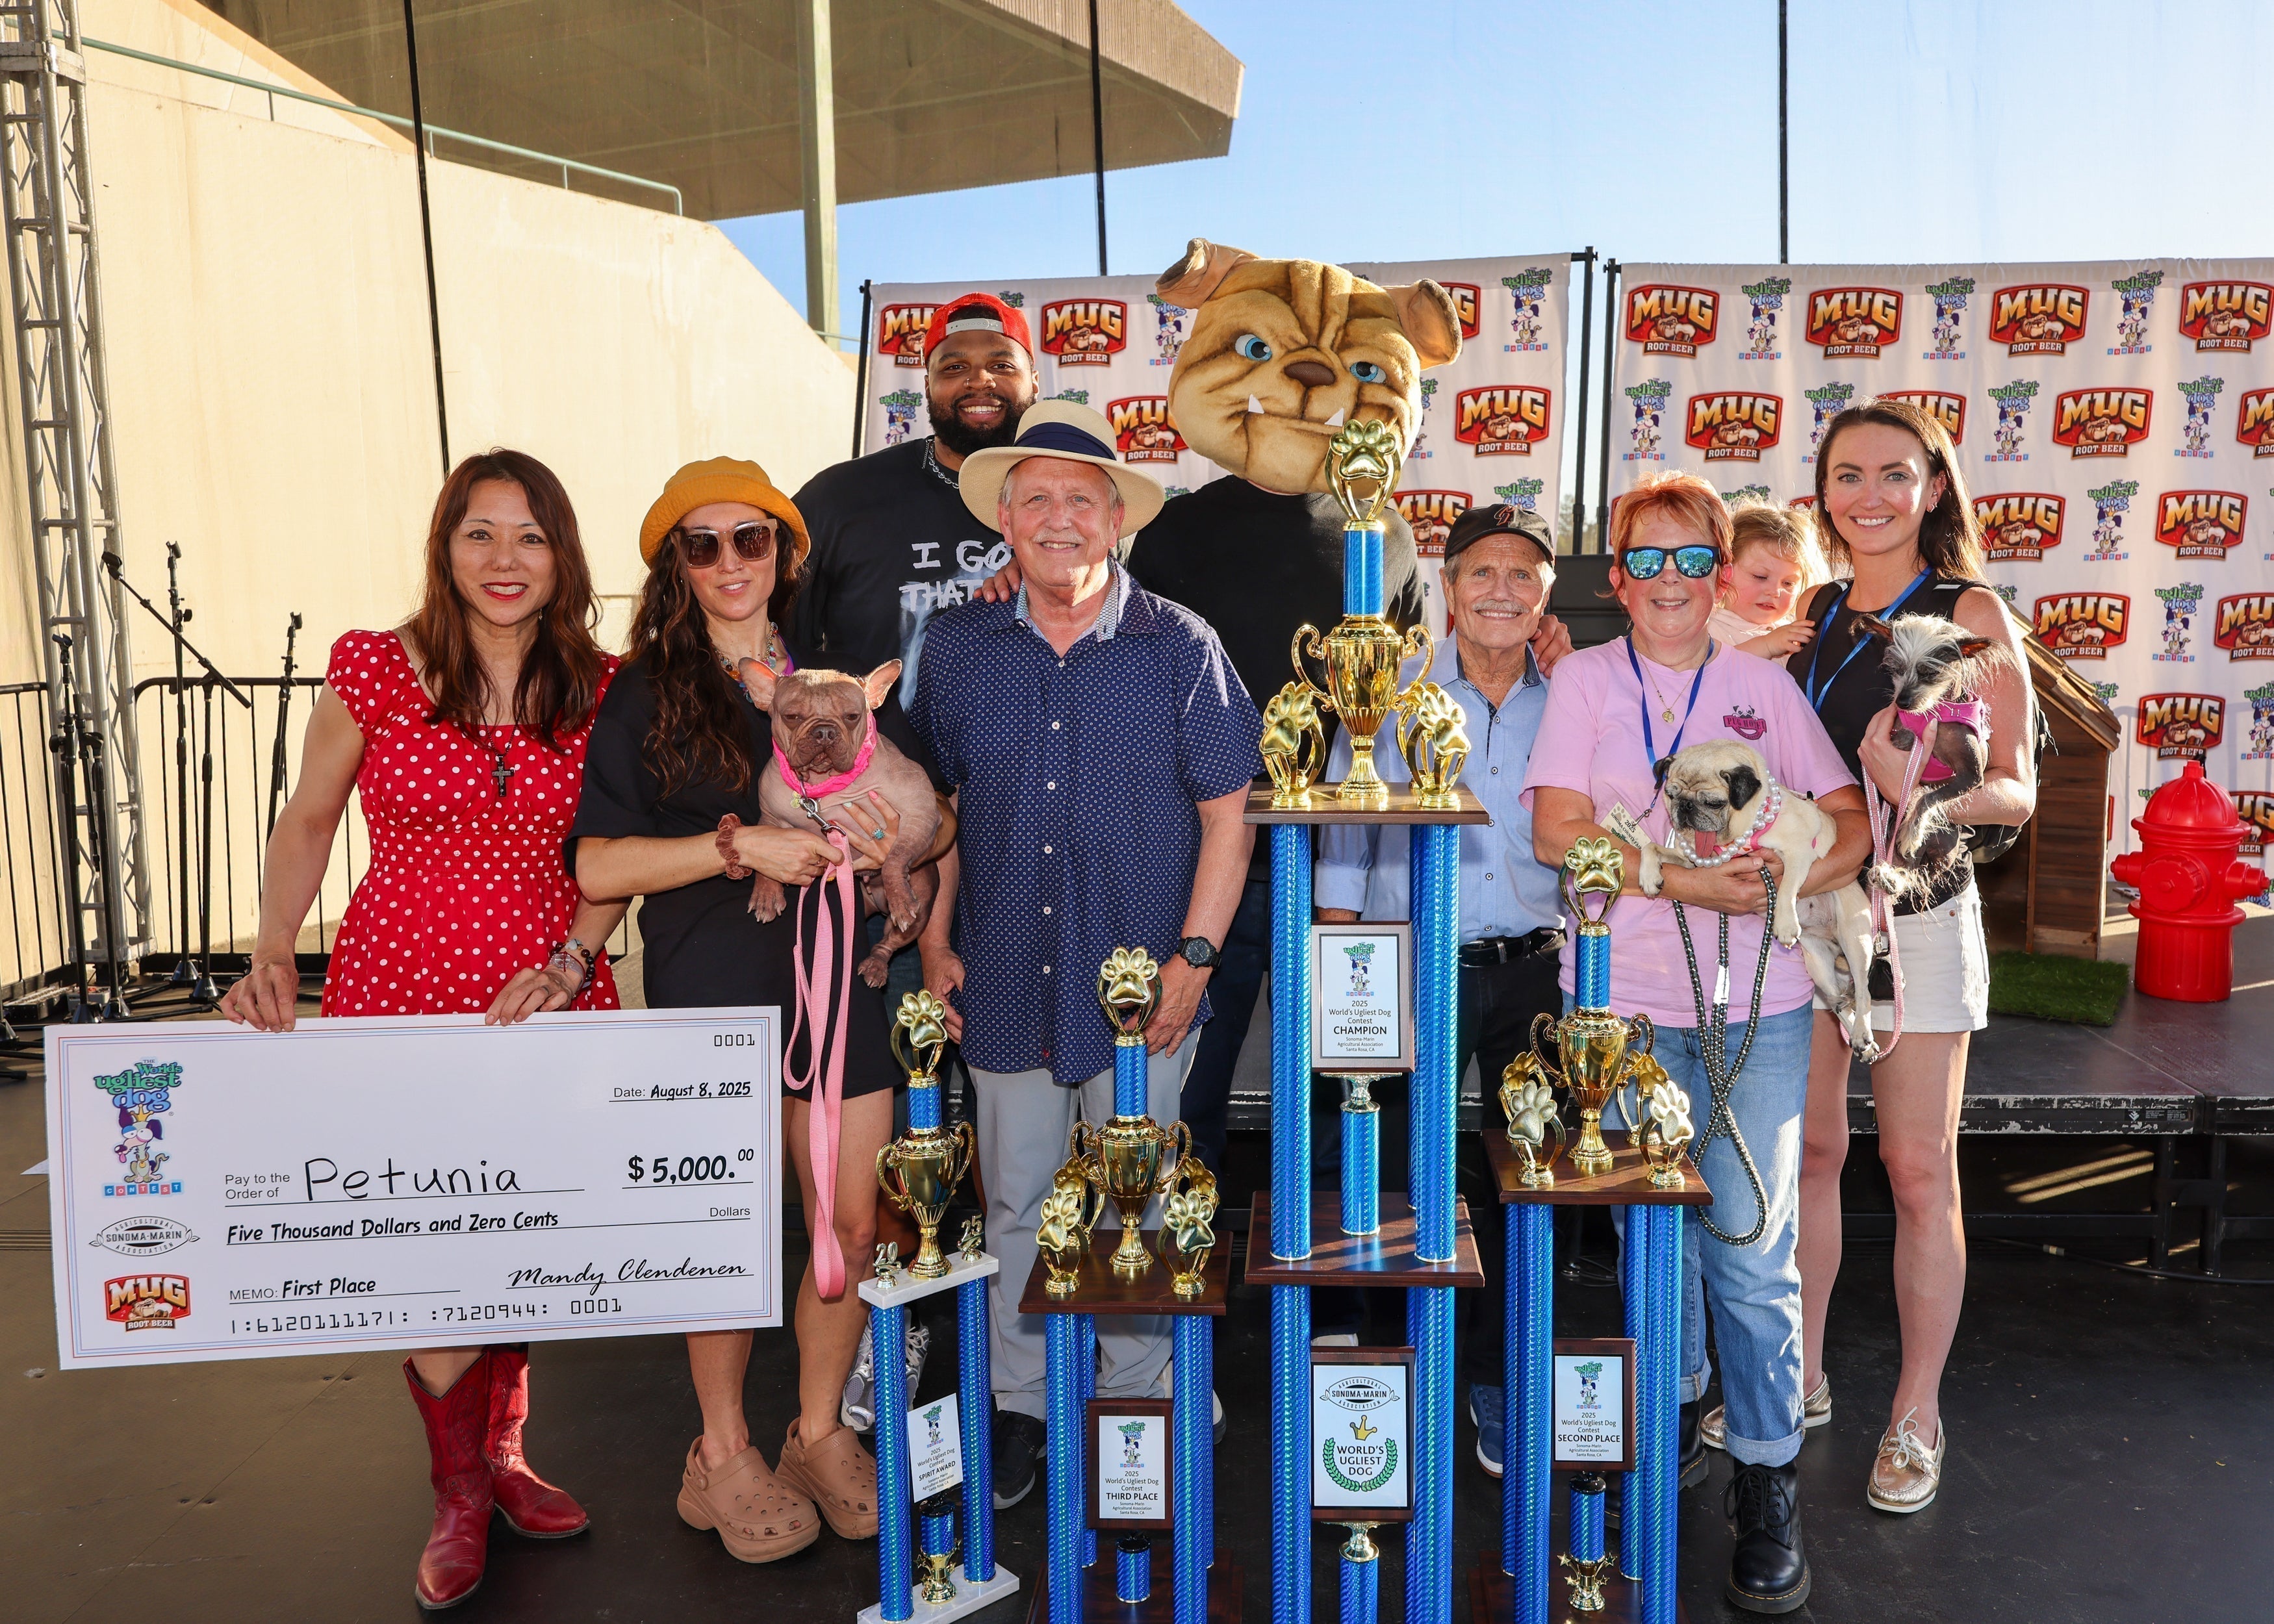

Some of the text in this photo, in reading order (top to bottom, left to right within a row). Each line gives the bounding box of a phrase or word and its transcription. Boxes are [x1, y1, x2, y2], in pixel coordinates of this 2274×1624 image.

[2112, 275, 2162, 292] ugliest
[2121, 287, 2154, 303] dog
[1632, 289, 1714, 332] MUG
[1996, 288, 2083, 331] MUG
[2185, 285, 2269, 325] MUG
[1813, 292, 1897, 333] MUG
[1046, 303, 1122, 344] MUG
[1671, 344, 1693, 353] BEER
[1828, 346, 1877, 354] ROOT BEER
[2012, 343, 2036, 352] ROOT
[2224, 340, 2248, 348] BEER
[1062, 353, 1107, 362] ROOT BEER
[1461, 389, 1545, 432] MUG
[1692, 396, 1776, 435] MUG
[2059, 392, 2146, 433] MUG
[1478, 444, 1501, 452] ROOT
[1708, 449, 1757, 457] ROOT BEER
[2076, 446, 2099, 455] ROOT
[2088, 485, 2138, 500] ugliest
[2096, 497, 2128, 511] dog
[1977, 497, 2060, 534] MUG
[2163, 494, 2242, 533] MUG
[912, 542, 941, 569] I
[1991, 549, 2039, 559] ROOT BEER
[2204, 547, 2223, 555] BEER
[899, 579, 983, 611] THAT
[2155, 587, 2203, 600] ugliest
[2164, 598, 2196, 613] dog
[2038, 596, 2123, 635] MUG
[2144, 697, 2220, 734] MUG
[1611, 812, 1623, 828] SONOMA
[1623, 828, 1635, 842] COUNTY
[1378, 1009, 1391, 1017] Dog
[1333, 1026, 1386, 1034] CHAMPION
[714, 1035, 754, 1047] 0001
[135, 1062, 183, 1075] World's
[94, 1070, 181, 1095] ugliest
[614, 1082, 751, 1100] Date: August 8, 2025
[112, 1087, 171, 1112] dog
[225, 1173, 290, 1186] Pay to the
[304, 1158, 521, 1201] Petunia
[105, 1182, 181, 1196] CONTEST
[225, 1187, 279, 1200] Order of
[709, 1206, 750, 1217] Dollars
[115, 1219, 173, 1232] AGRICULTURAL
[227, 1211, 559, 1243] Five Thousand Dollars and Zero Cents
[116, 1242, 173, 1254] ASSOCIATION
[508, 1258, 747, 1296] Mandy Clendenen
[109, 1276, 186, 1313] MUG
[230, 1277, 376, 1300] MEMO: First Place
[570, 1299, 621, 1314] 0001
[1338, 1378, 1381, 1389] AGRICULTURAL
[1338, 1399, 1381, 1408] ASSOCIATION
[1557, 1434, 1593, 1442] SECOND
[930, 1447, 941, 1455] 2025
[1336, 1445, 1384, 1454] WORLD'S
[917, 1456, 932, 1467] World's
[932, 1451, 946, 1462] Ugliest
[928, 1458, 944, 1468] Contest
[1340, 1456, 1381, 1465] UGLIEST
[918, 1460, 956, 1481] SPIRIT AWARD
[1348, 1466, 1372, 1475] DOG
